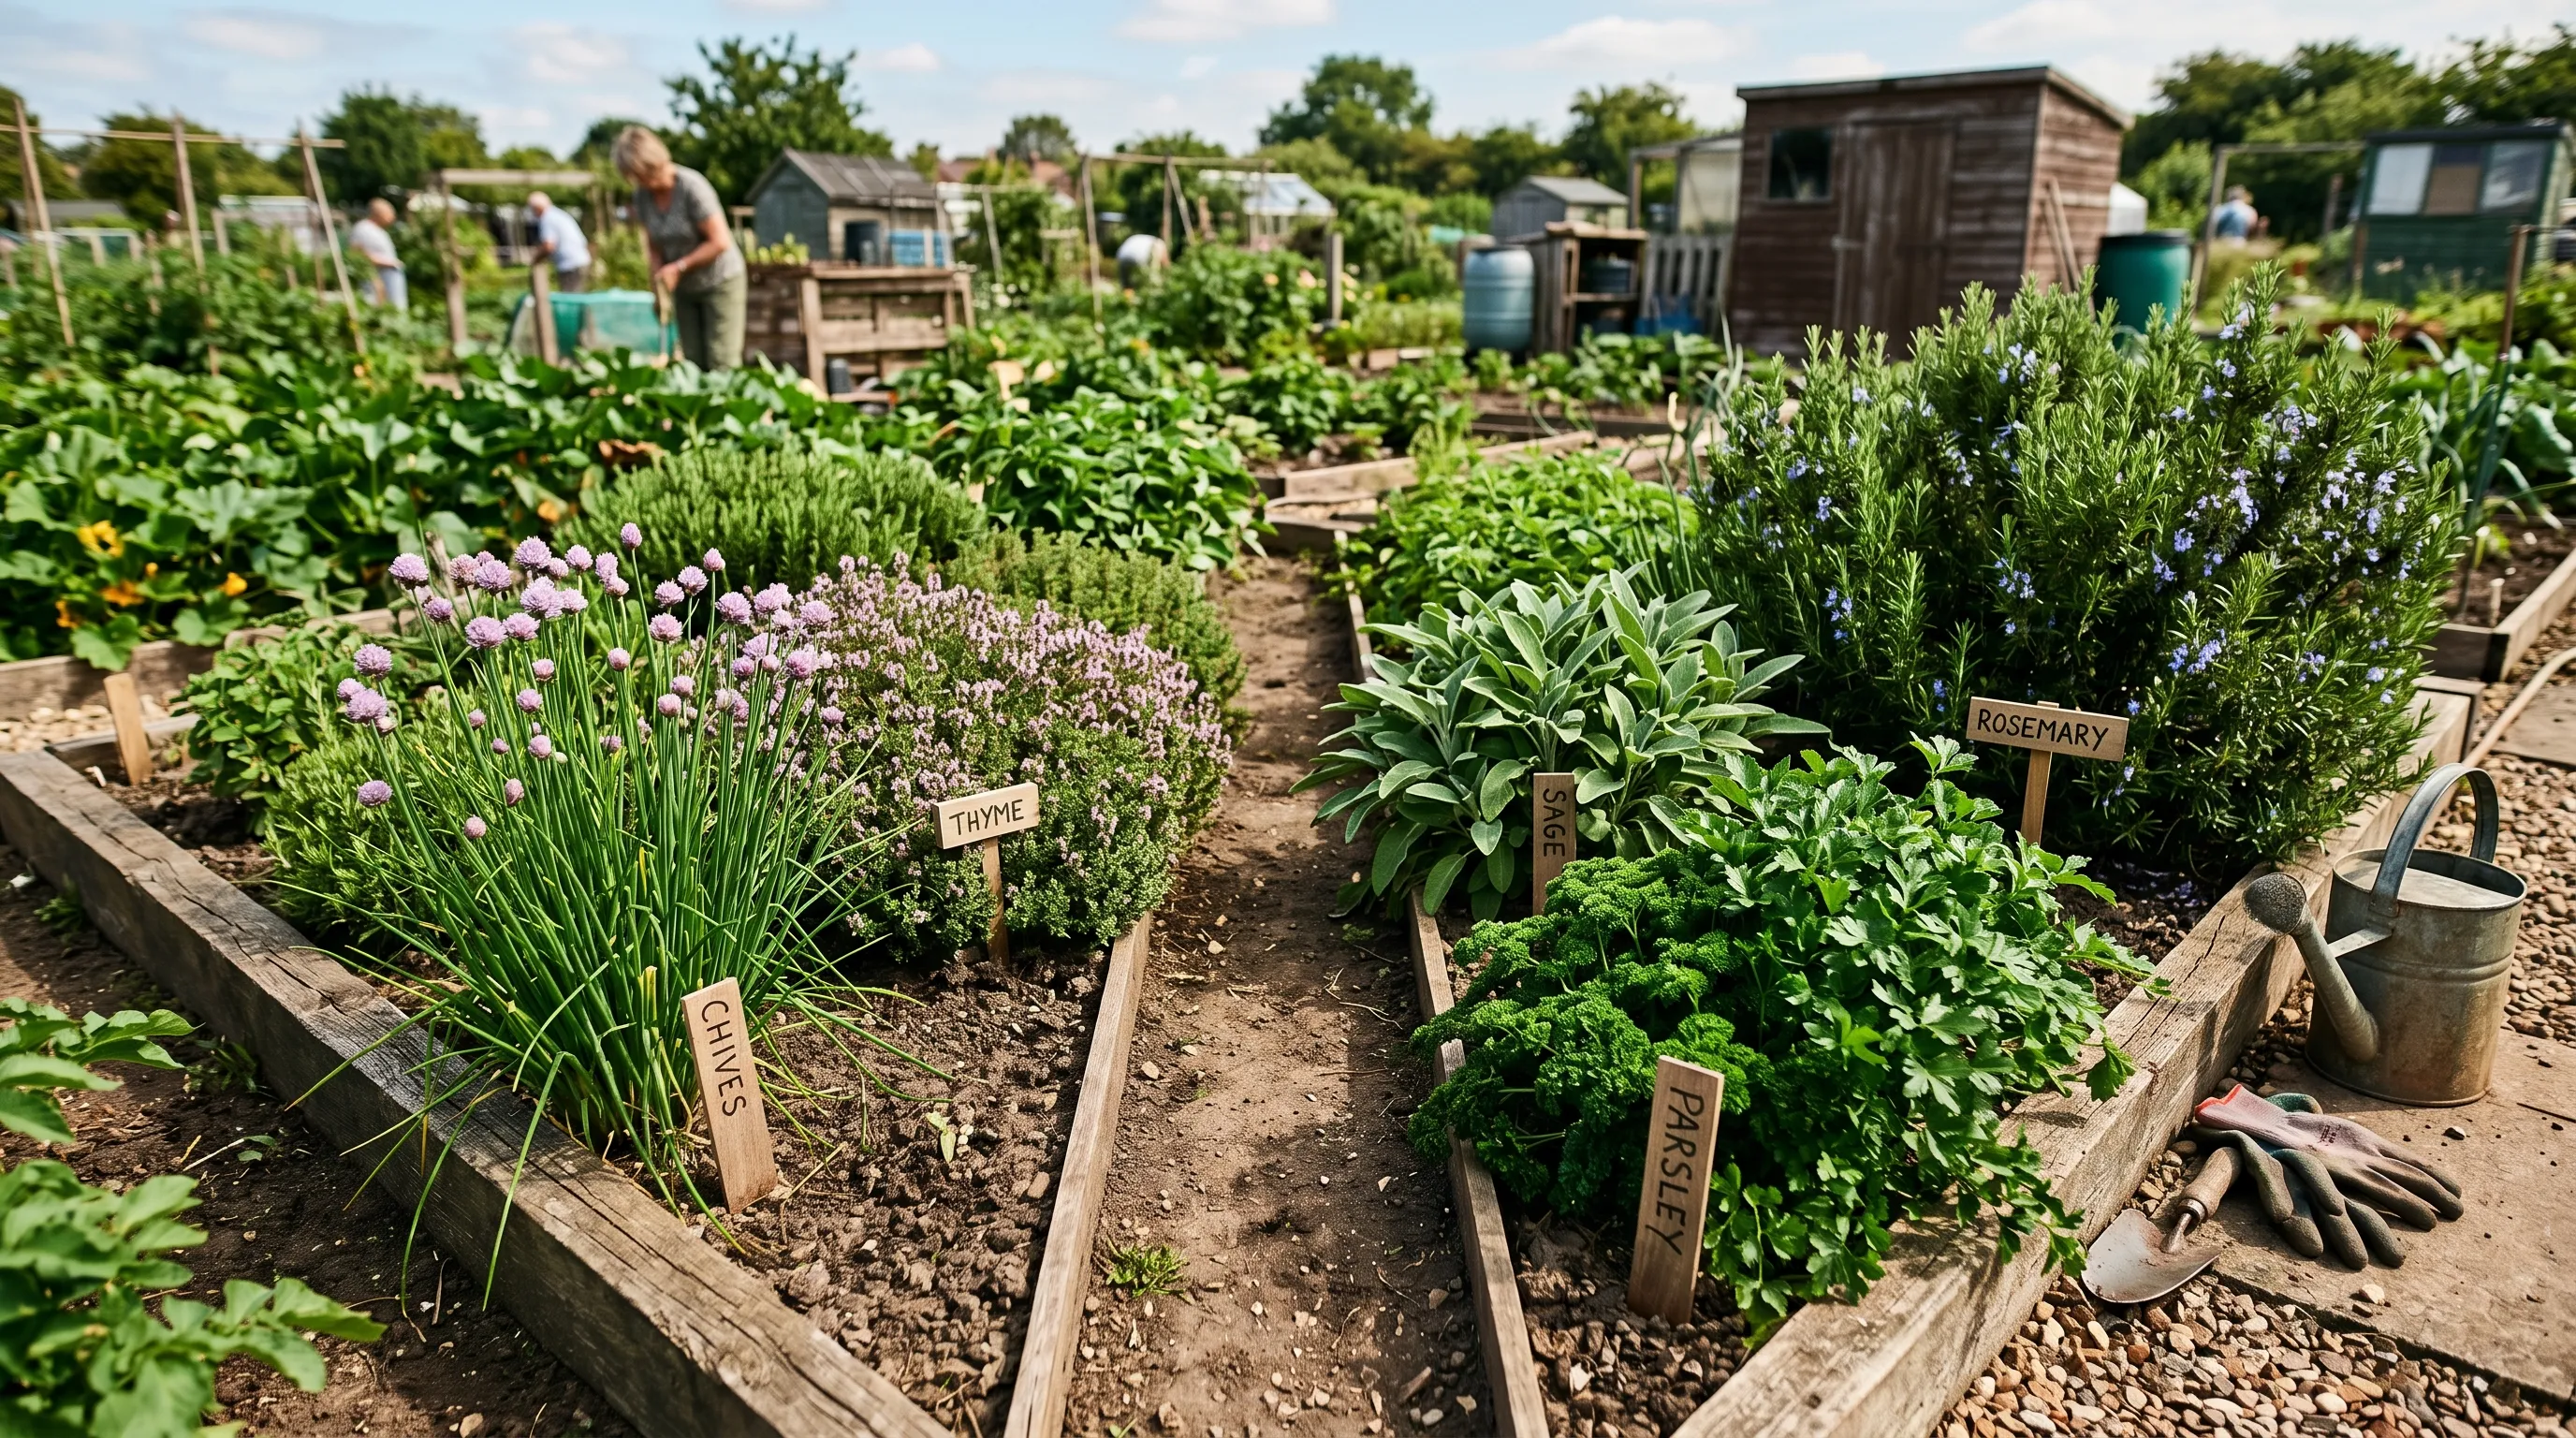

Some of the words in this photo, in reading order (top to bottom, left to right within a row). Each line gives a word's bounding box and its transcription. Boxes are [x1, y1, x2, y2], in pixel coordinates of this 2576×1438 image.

[1977, 708, 2109, 751] ROSEMARY
[948, 799, 1025, 836] THYME
[1543, 788, 1567, 857] SAGE
[701, 1000, 747, 1117] CHIVES
[1645, 1086, 1705, 1256] PARSLEY
